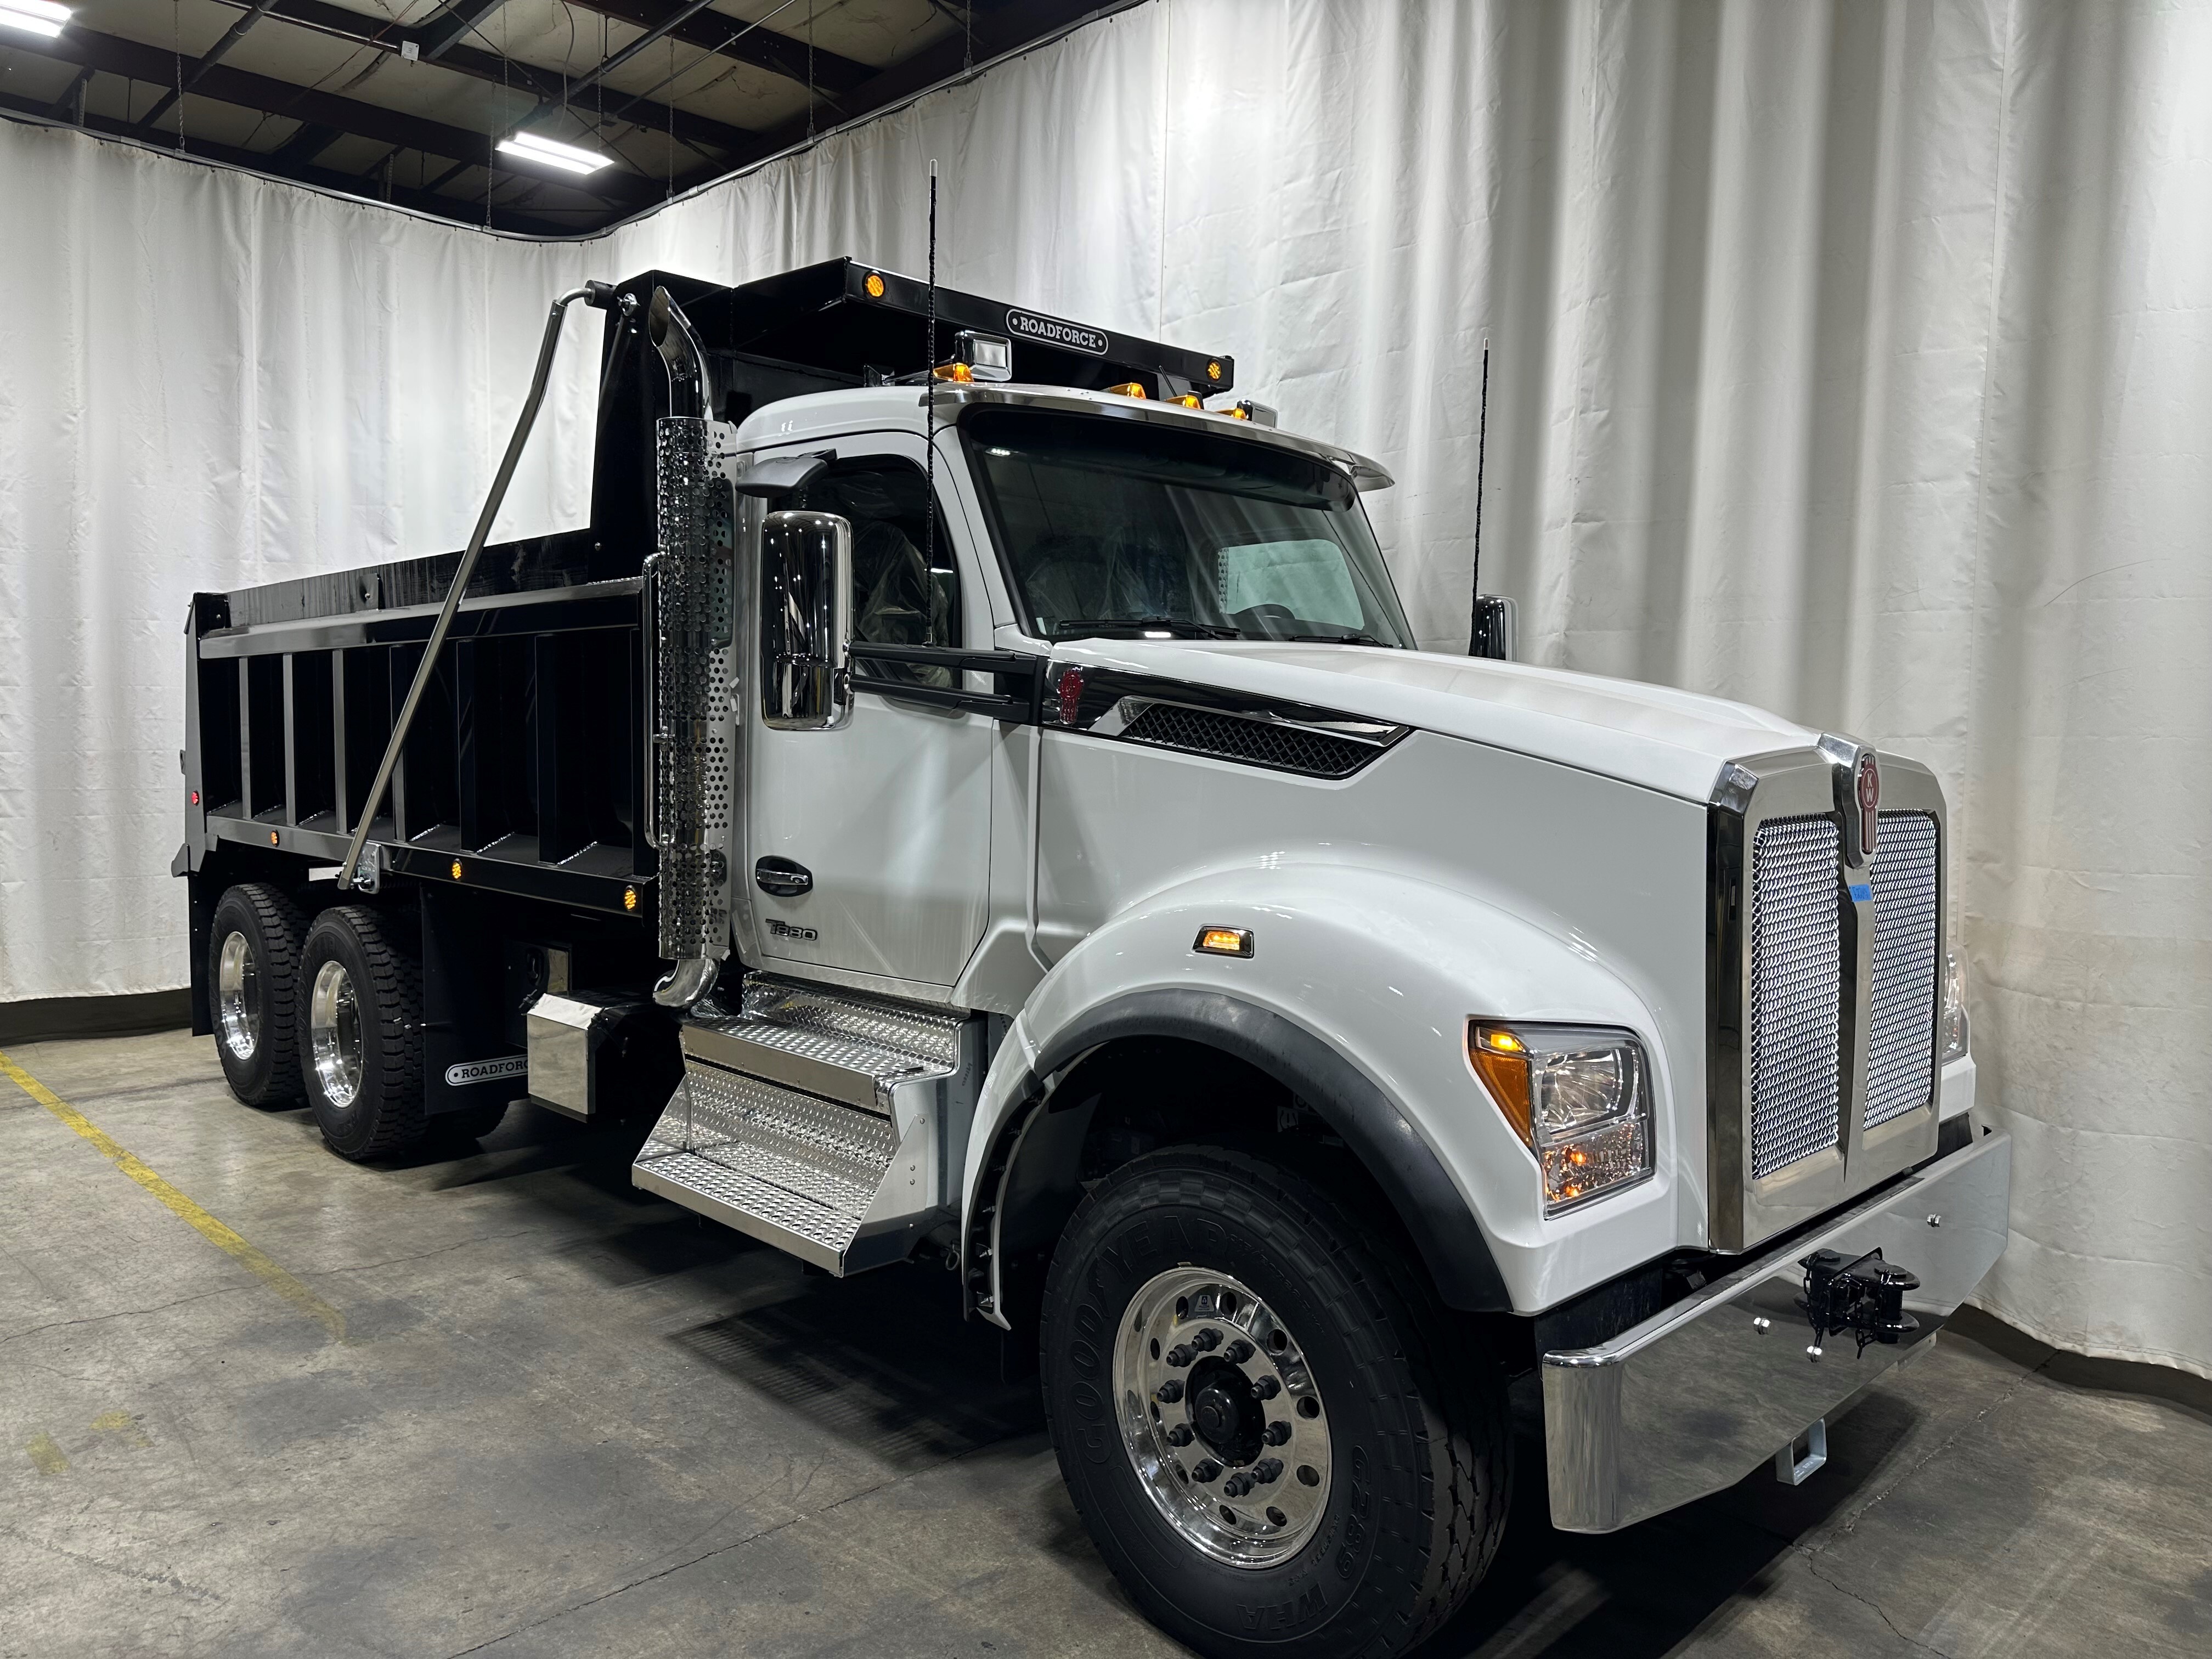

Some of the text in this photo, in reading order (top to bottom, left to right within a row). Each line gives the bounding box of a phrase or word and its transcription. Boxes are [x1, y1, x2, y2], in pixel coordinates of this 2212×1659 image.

[1019, 316, 1096, 348] ROADFORCE
[765, 918, 818, 941] T880
[961, 1062, 972, 1087] Nitto
[1237, 1444, 1372, 1632] G289 WHA
